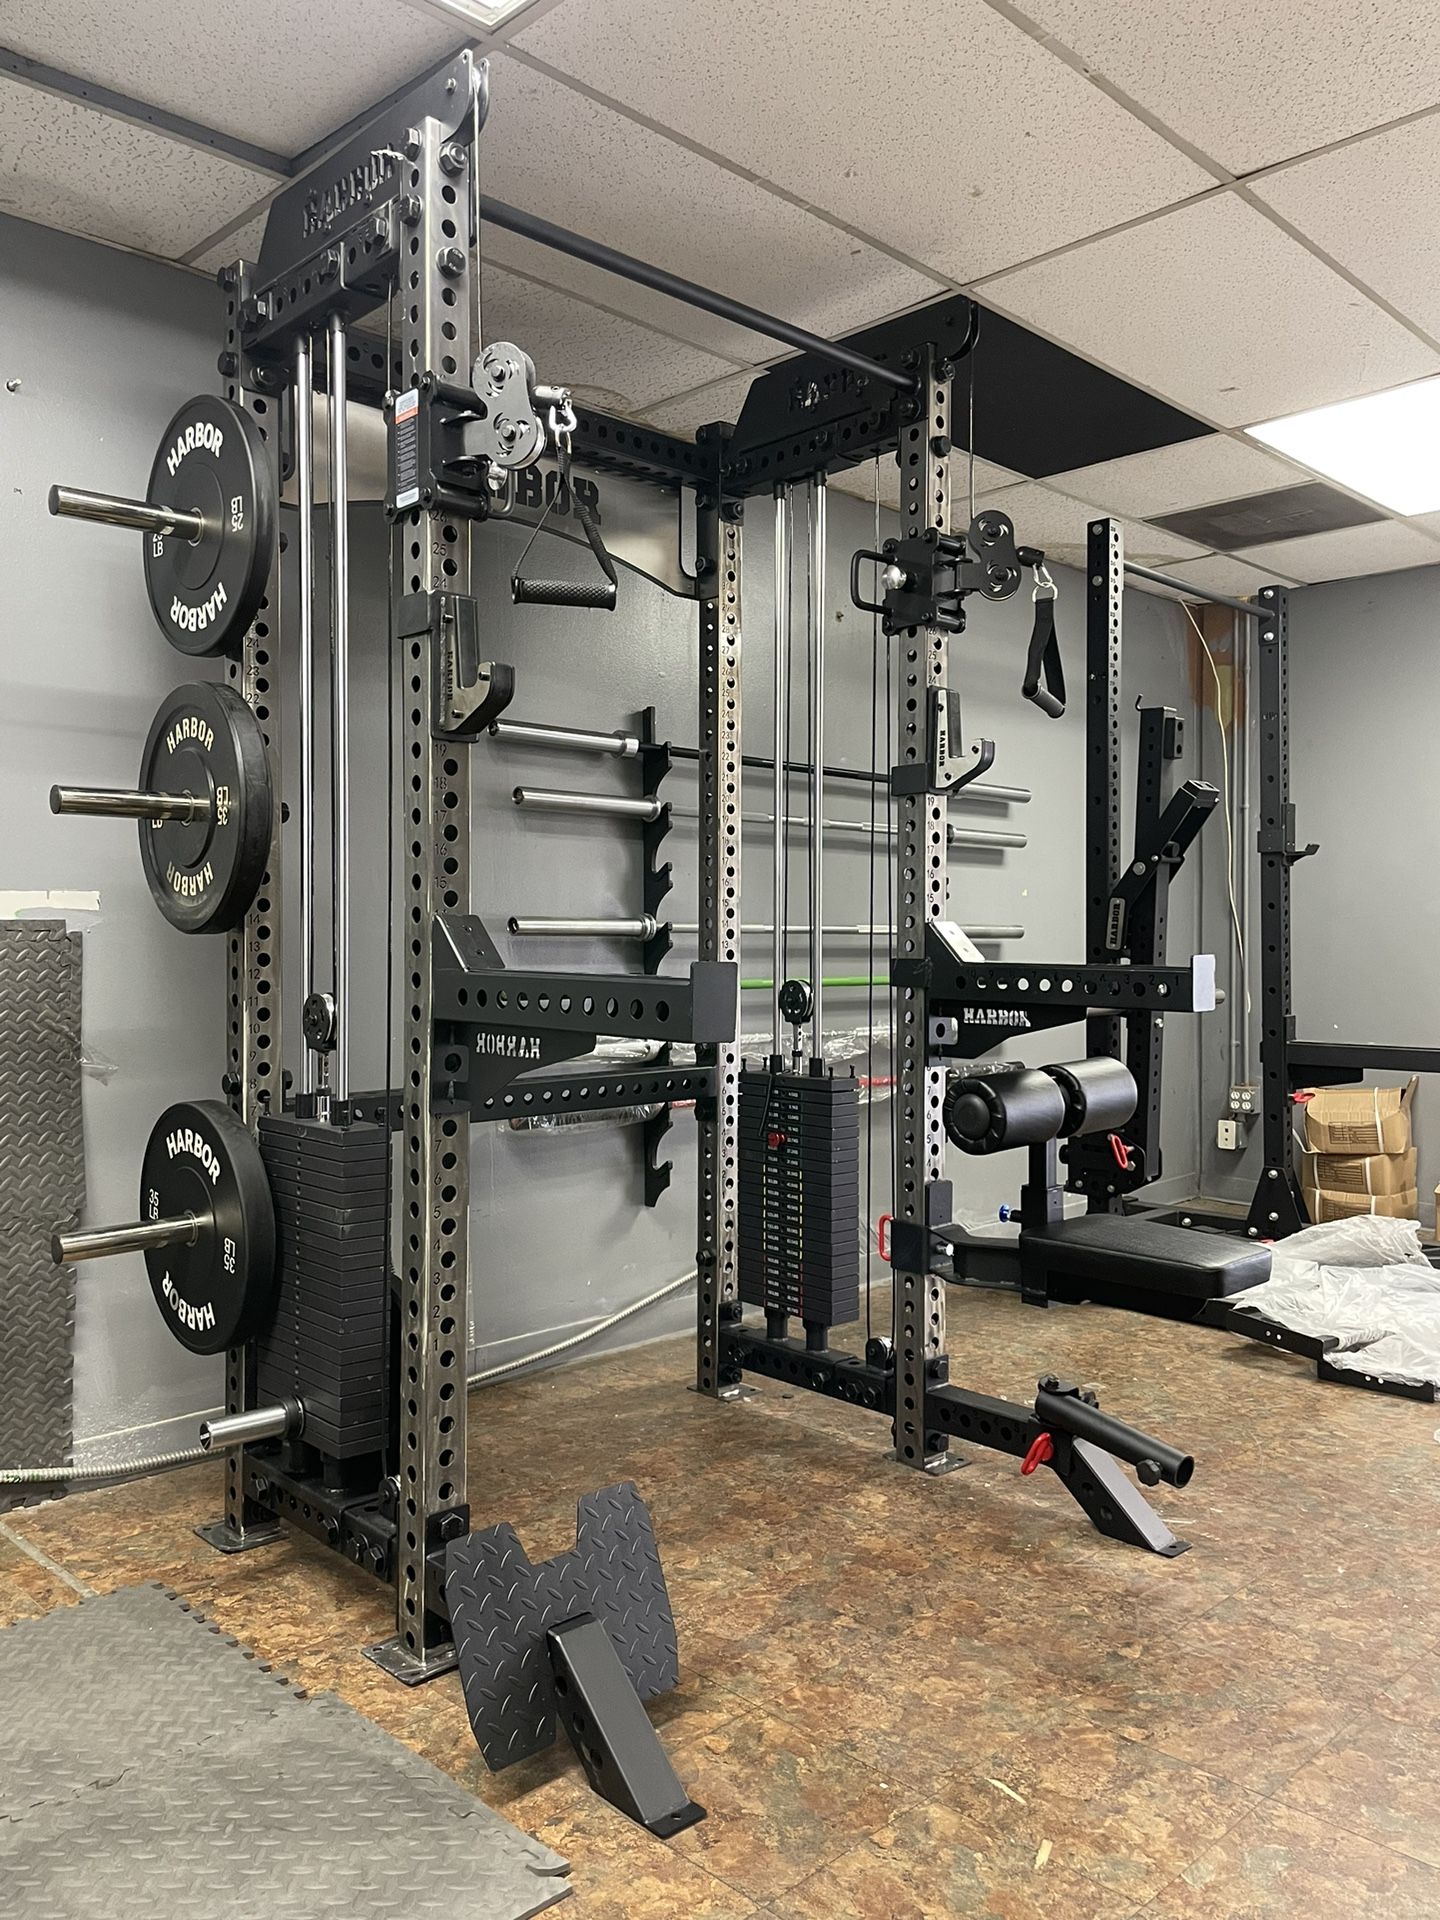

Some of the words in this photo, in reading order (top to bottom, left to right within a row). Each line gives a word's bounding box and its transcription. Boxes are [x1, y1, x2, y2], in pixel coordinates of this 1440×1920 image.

[166, 422, 224, 477] HARBOR
[231, 495, 242, 514] LB
[433, 510, 447, 522] 26
[231, 512, 243, 532] 25
[153, 541, 163, 558] LB
[433, 542, 447, 556] 25
[433, 576, 447, 589] 24
[170, 582, 228, 632] HARBOR
[246, 637, 260, 648] 24
[722, 646, 730, 654] 27
[928, 650, 936, 660] 25
[247, 665, 260, 676] 23
[722, 688, 730, 697] 25
[247, 693, 260, 704] 22
[166, 717, 215, 754] HARBOR
[722, 731, 730, 739] 23
[435, 744, 447, 757] 19
[722, 752, 730, 760] 22
[435, 777, 447, 790] 18
[722, 794, 730, 802] 20
[927, 796, 934, 806] 19
[217, 806, 228, 825] 35
[435, 810, 447, 823] 17
[927, 821, 934, 830] 18
[435, 843, 447, 856] 16
[927, 845, 934, 854] 17
[722, 857, 729, 865] 17
[166, 861, 214, 897] HARBOR
[927, 869, 934, 879] 16
[435, 876, 447, 889] 15
[722, 878, 729, 886] 16
[722, 899, 729, 907] 15
[927, 893, 934, 903] 15
[249, 914, 260, 925] 14
[249, 942, 260, 952] 13
[722, 941, 729, 949] 13
[249, 969, 260, 980] 12
[1124, 974, 1129, 984] 3
[1148, 974, 1155, 985] 2
[1175, 976, 1179, 986] 1
[249, 996, 259, 1006] 11
[963, 1008, 1031, 1028] HARBOR
[249, 1024, 260, 1034] 10
[250, 1051, 256, 1061] 9
[722, 1066, 726, 1074] 7
[250, 1079, 257, 1089] 8
[722, 1087, 726, 1095] 6
[927, 1087, 932, 1095] 7
[250, 1106, 256, 1116] 7
[927, 1111, 932, 1120] 6
[926, 1134, 931, 1144] 5
[435, 1140, 442, 1152] 7
[166, 1128, 221, 1186] HARBOR
[722, 1149, 726, 1158] 3
[434, 1173, 441, 1185] 6
[722, 1170, 726, 1179] 2
[149, 1188, 159, 1207] 35
[434, 1207, 441, 1219] 5
[224, 1237, 235, 1258] LB
[434, 1239, 441, 1252] 4
[224, 1256, 235, 1275] 35
[433, 1272, 440, 1285] 3
[162, 1270, 216, 1332] HARBOR
[433, 1305, 440, 1318] 2
[434, 1340, 438, 1351] 1
